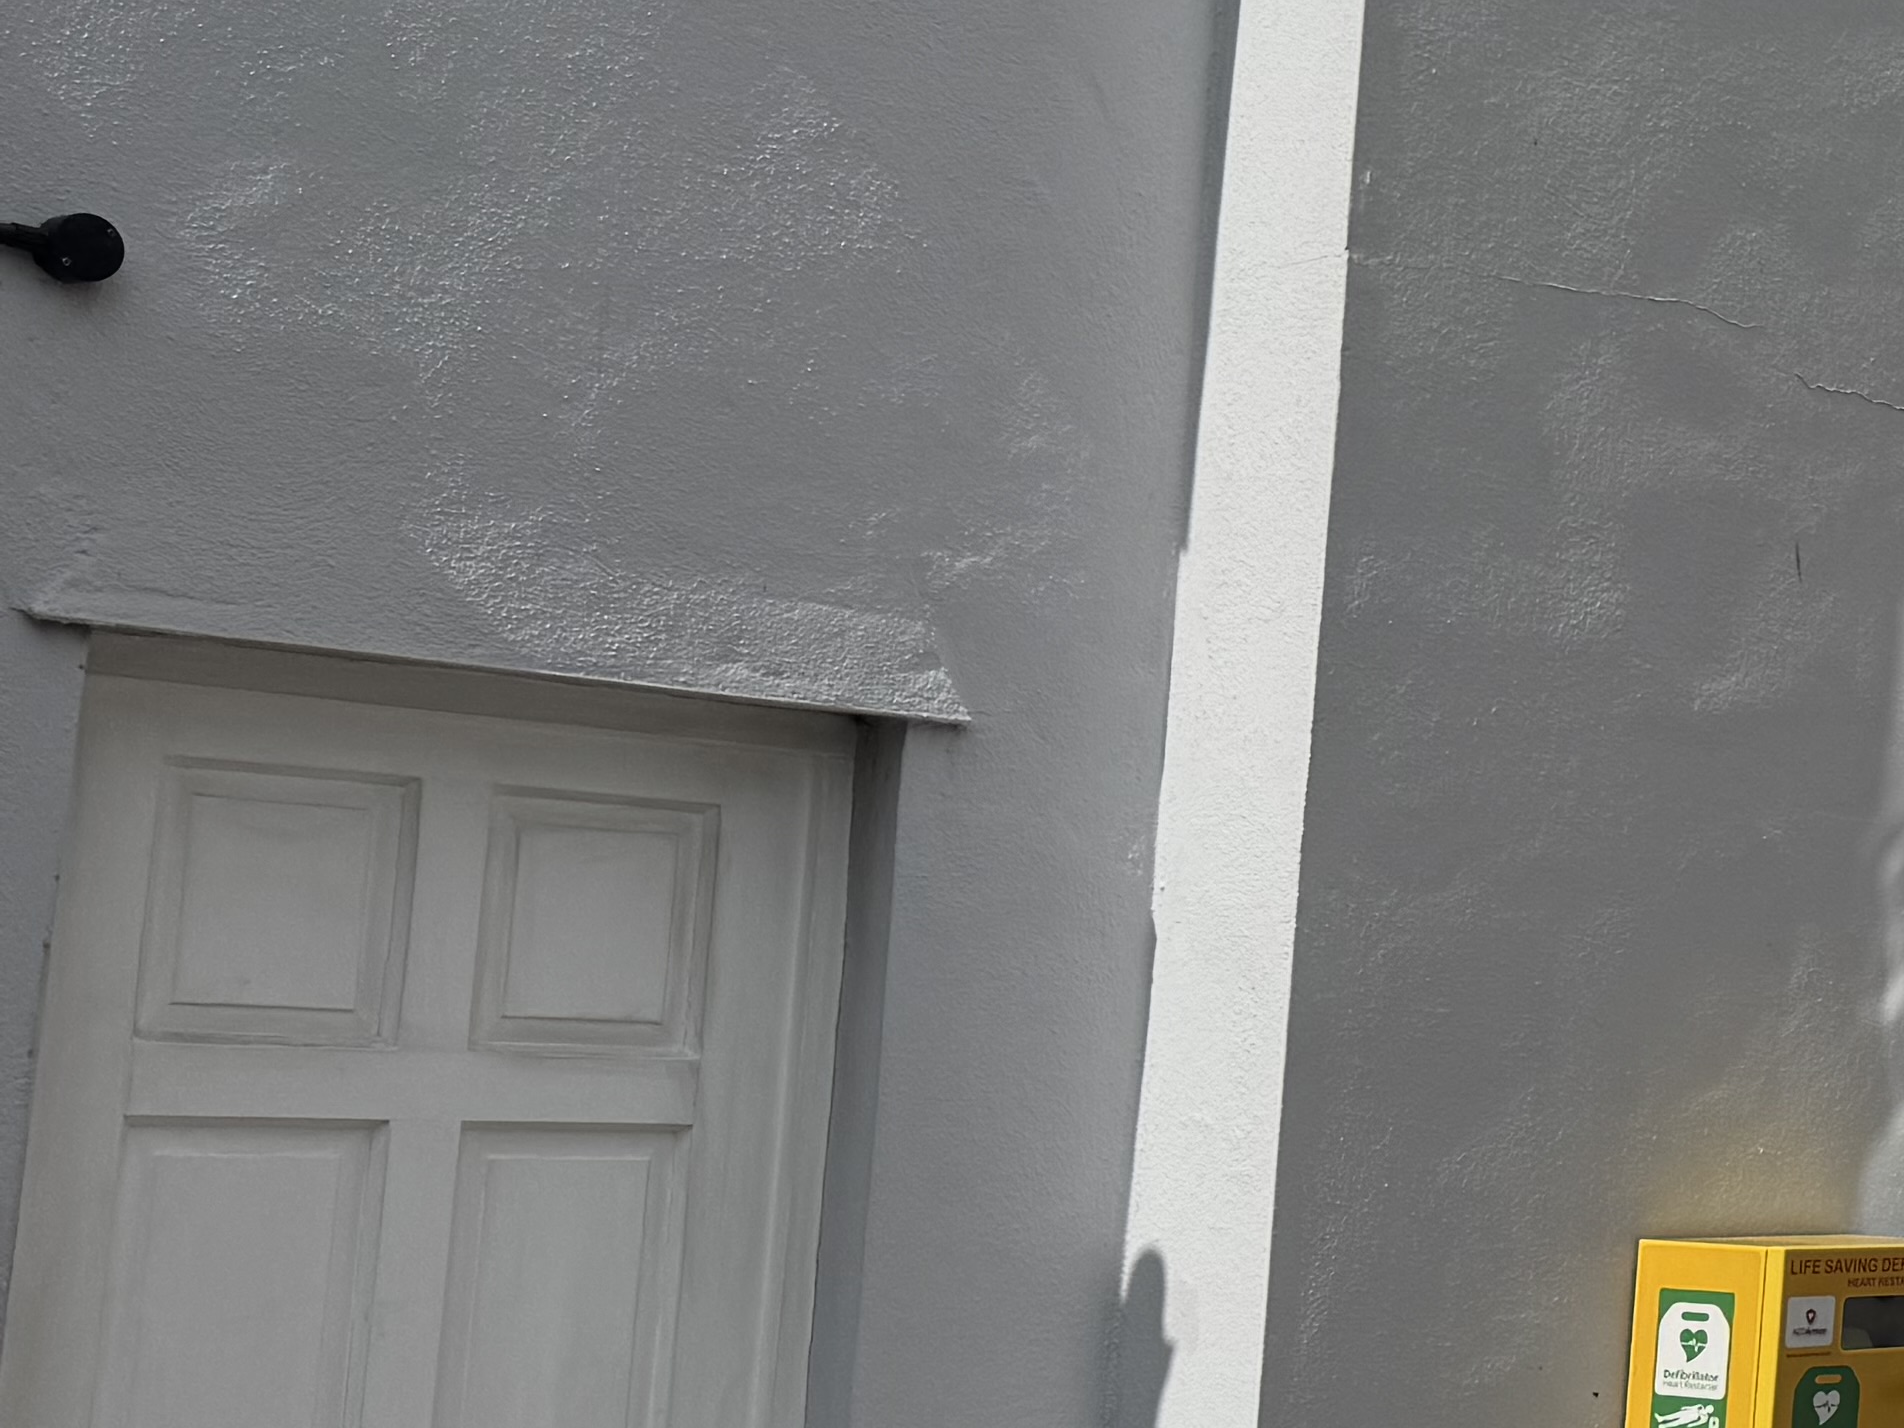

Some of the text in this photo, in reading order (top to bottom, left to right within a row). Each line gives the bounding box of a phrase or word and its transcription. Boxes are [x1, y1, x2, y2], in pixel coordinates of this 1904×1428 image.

[1790, 1259, 1822, 1275] LIFE
[1824, 1257, 1878, 1274] SAVING
[1848, 1277, 1876, 1288] HEART
[1663, 1369, 1719, 1382] Defibrillator
